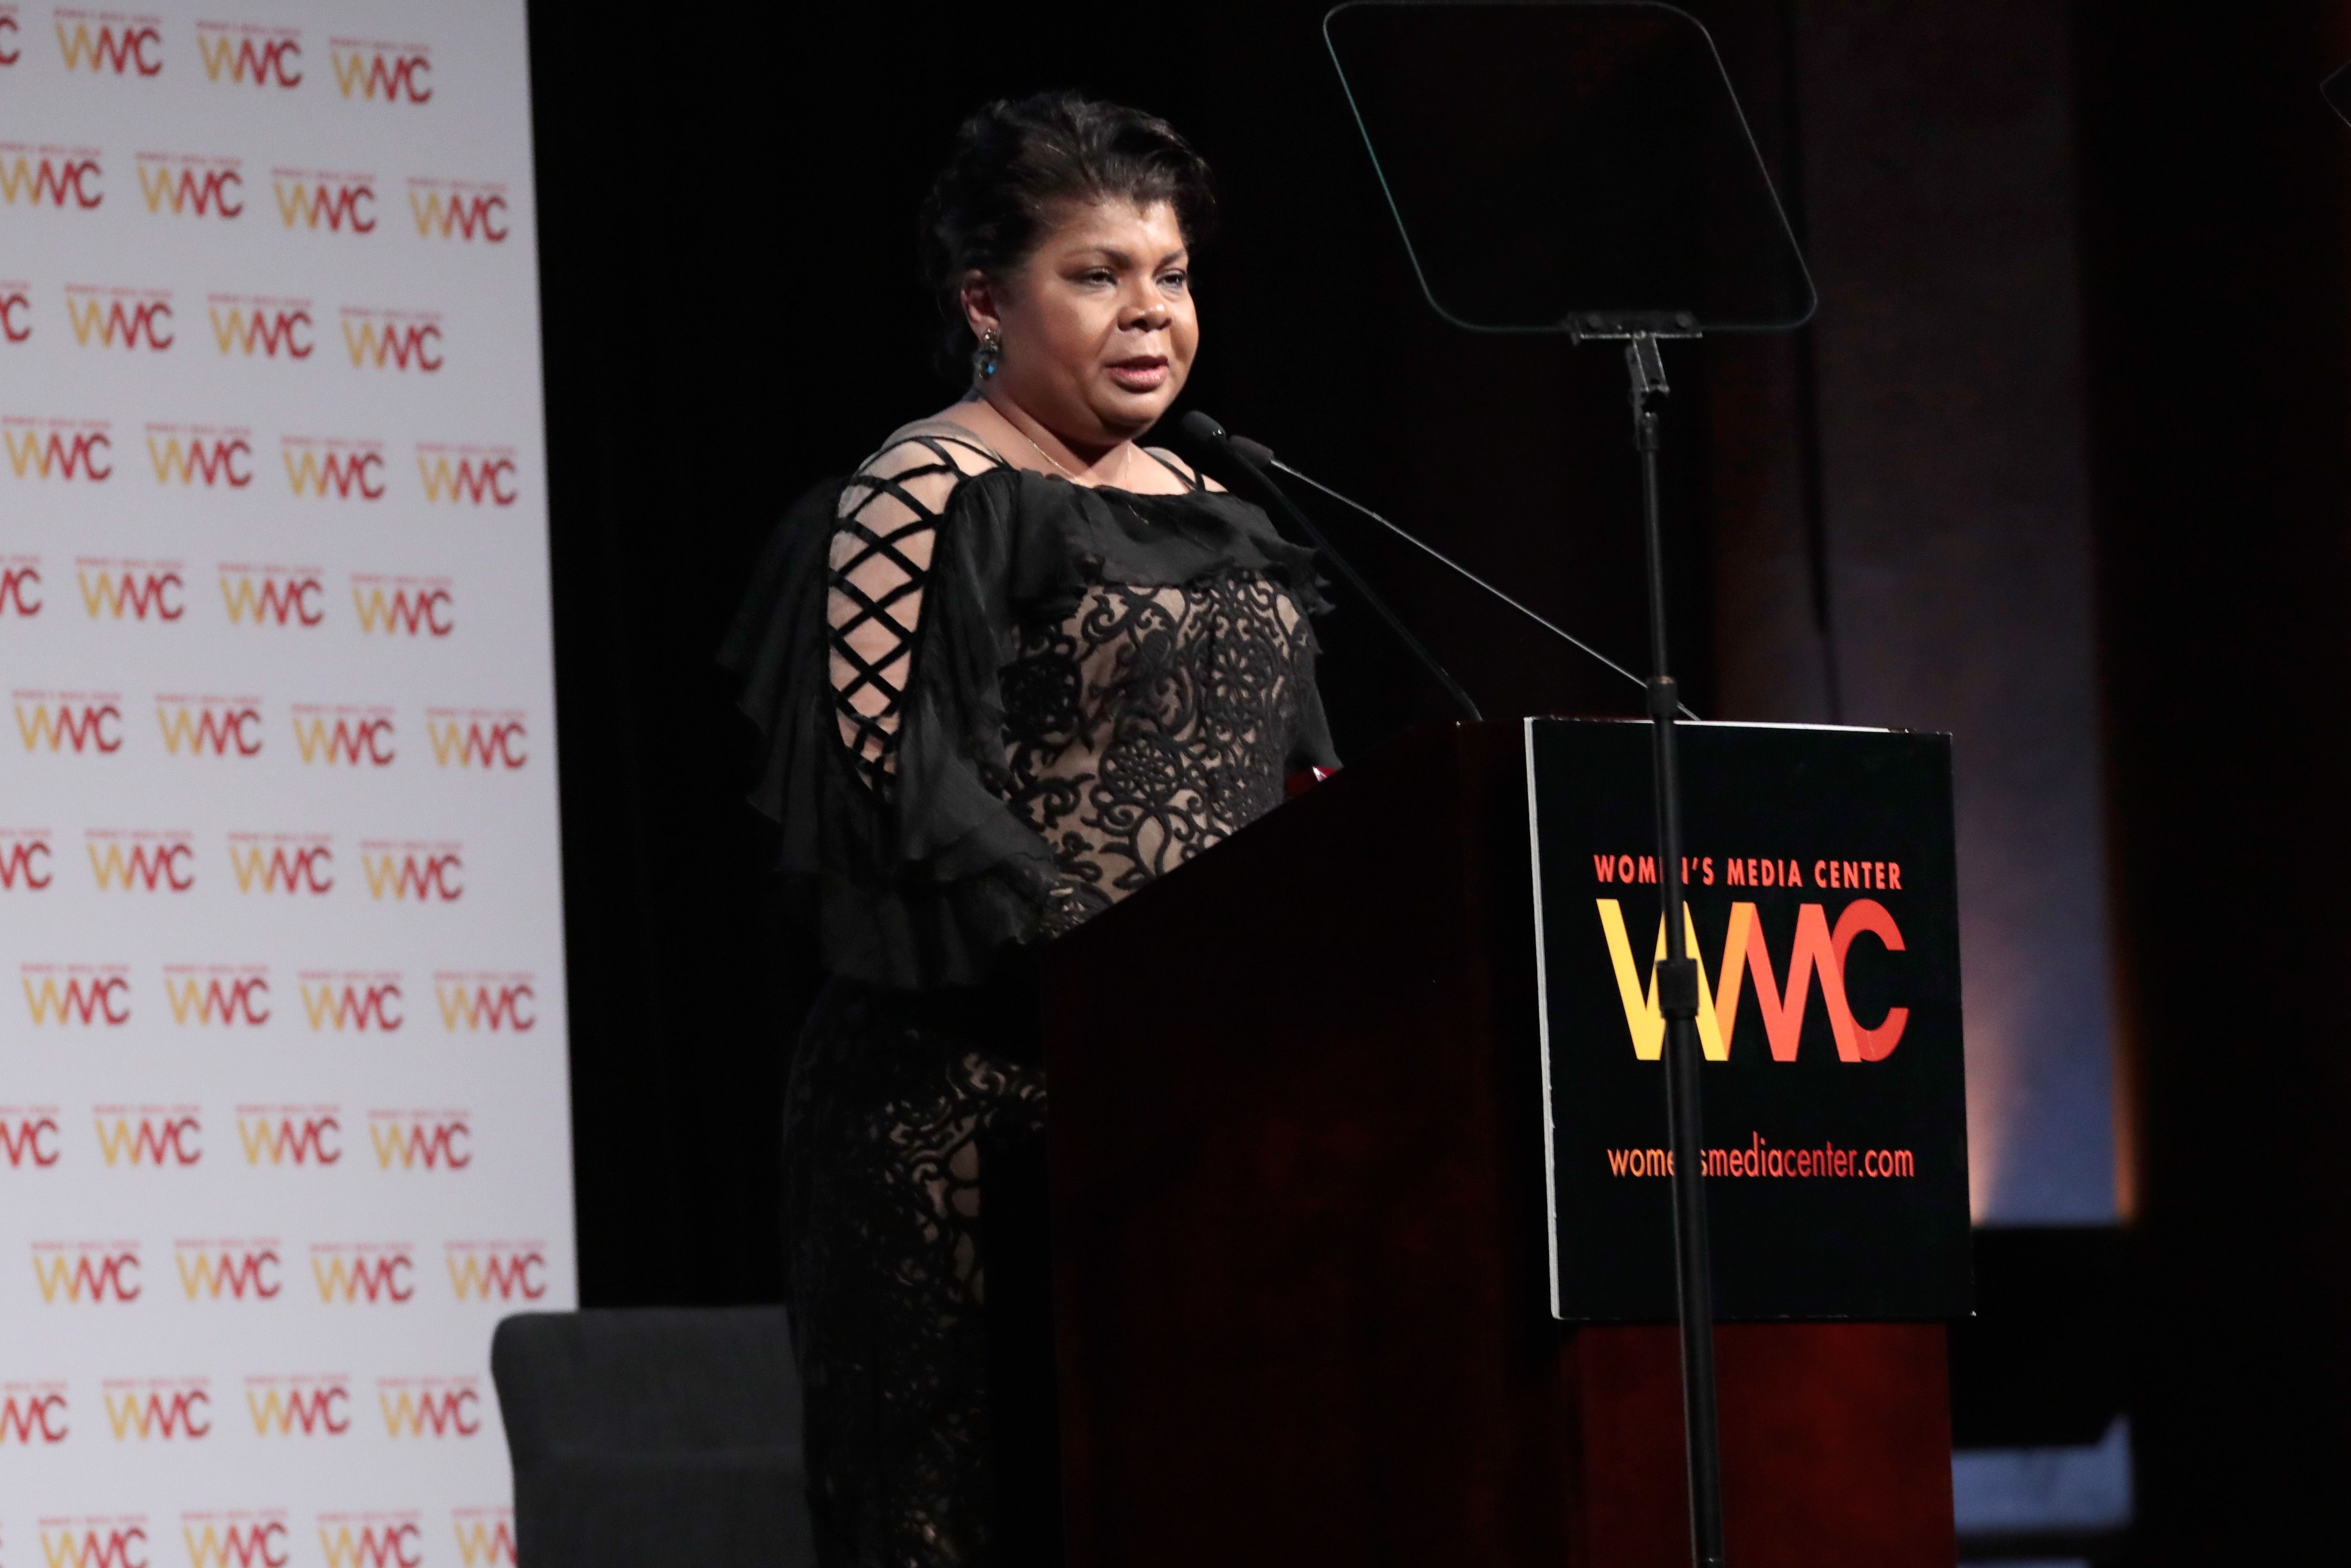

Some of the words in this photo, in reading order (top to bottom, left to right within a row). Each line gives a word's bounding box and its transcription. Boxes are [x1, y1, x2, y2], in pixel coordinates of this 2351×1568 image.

[1593, 854, 1715, 886] WOM'S
[1726, 857, 1804, 888] MEDIA
[1814, 859, 1903, 890] CENTER
[1596, 897, 1910, 1063] WMC
[0, 1117, 60, 1168] MC
[1607, 1131, 1915, 1178] womesmediacenter.com
[0, 1393, 68, 1444] MC
